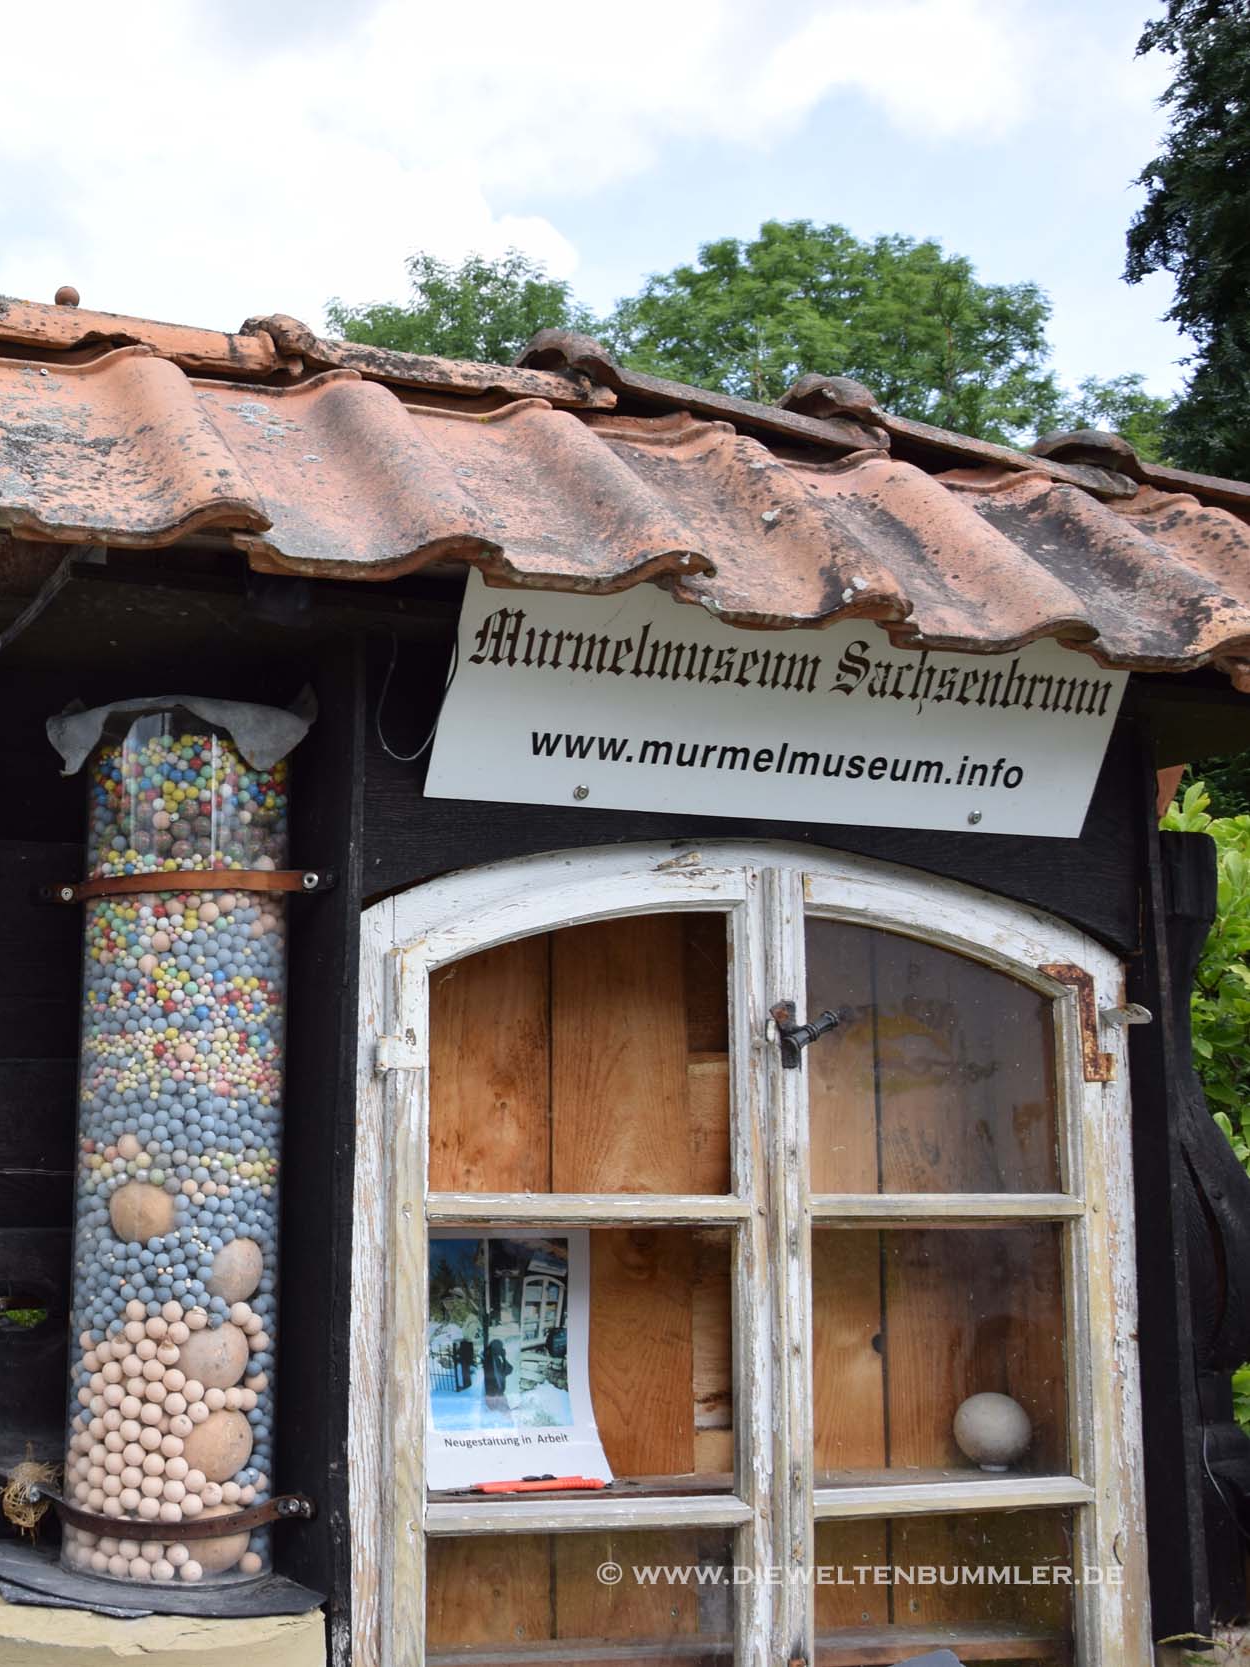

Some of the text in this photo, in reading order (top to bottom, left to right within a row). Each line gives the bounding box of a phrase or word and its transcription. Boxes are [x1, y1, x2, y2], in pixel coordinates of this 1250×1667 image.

[469, 608, 1113, 716] Murmelmuseum Sachsenbrunn
[531, 731, 1024, 789] www.murmelmuseum.info
[444, 1433, 569, 1448] Neugestaltung in Arbeit
